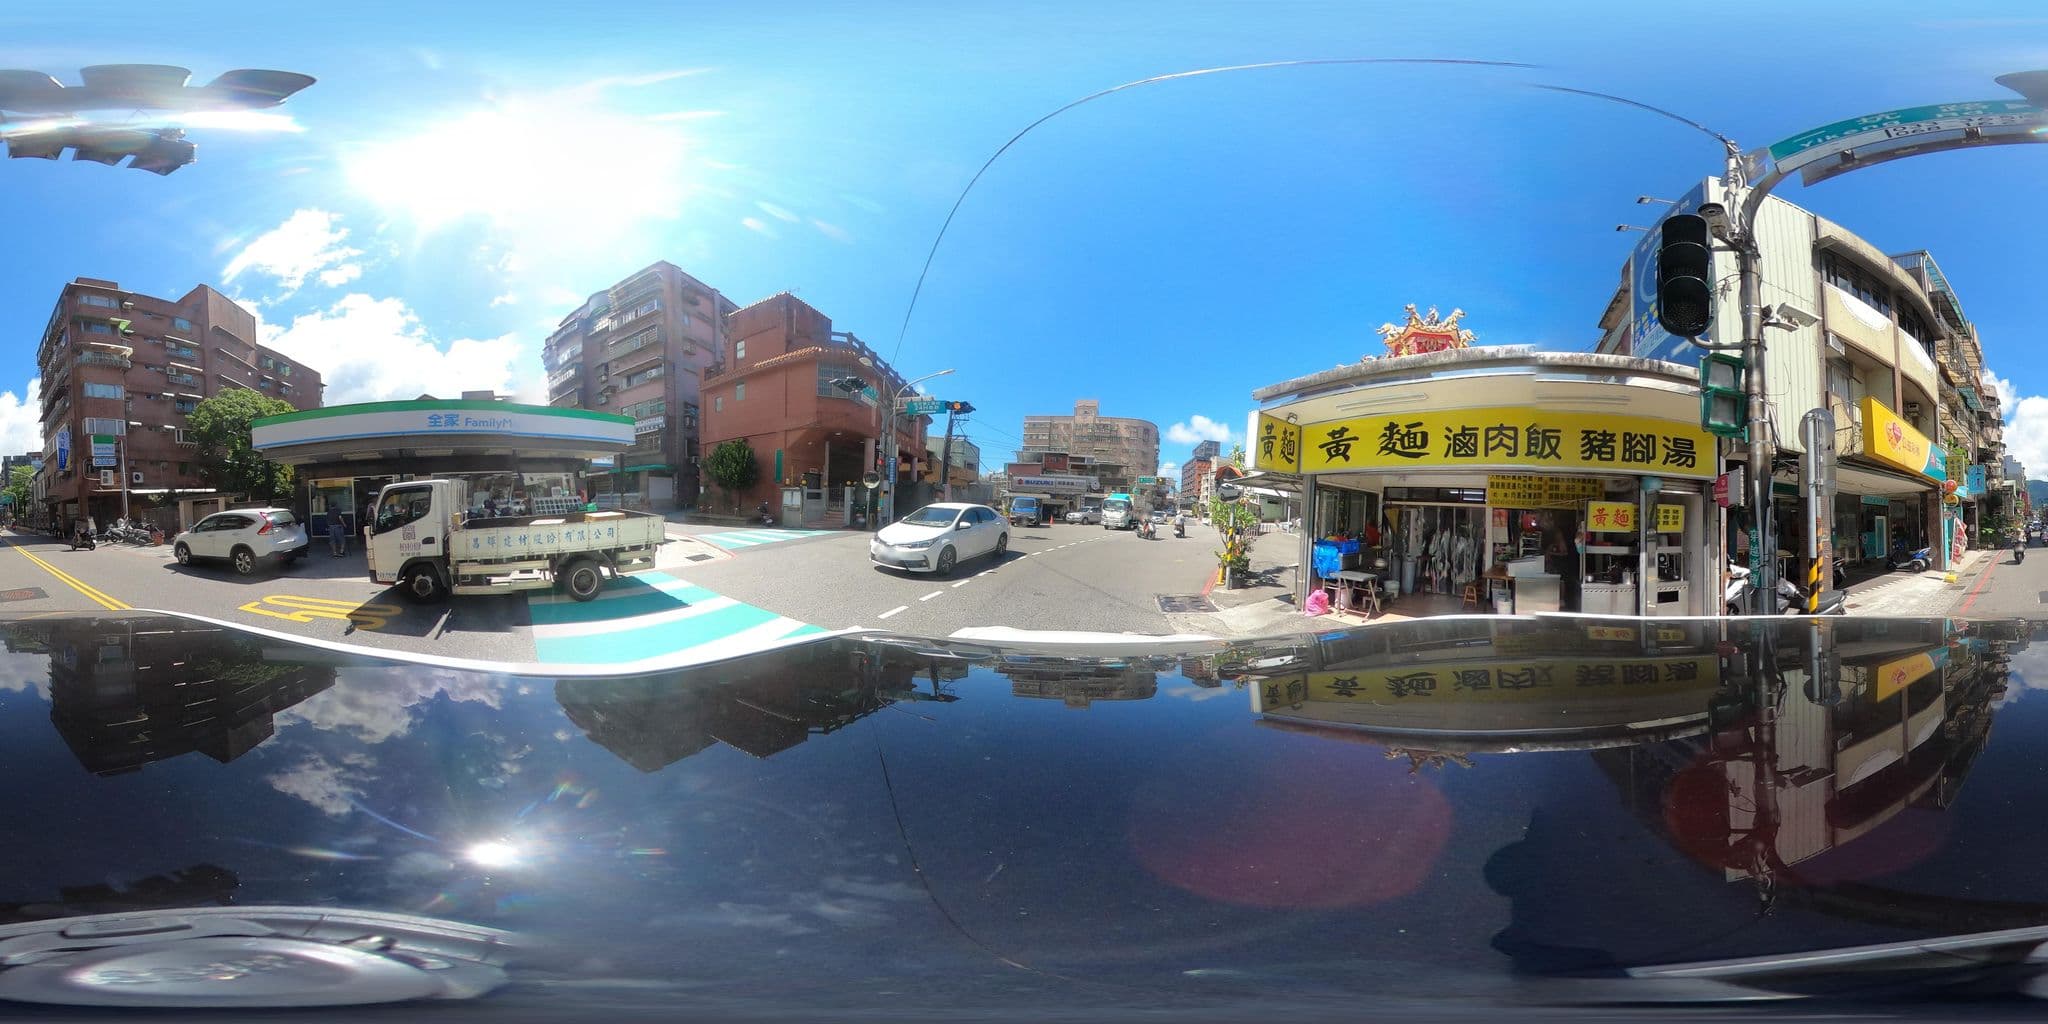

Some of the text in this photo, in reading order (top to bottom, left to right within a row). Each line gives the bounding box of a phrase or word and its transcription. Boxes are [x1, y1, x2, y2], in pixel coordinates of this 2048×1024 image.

[1800, 120, 1902, 147] Yikeng
[428, 413, 460, 428] 全家
[1260, 423, 1296, 464] 黃麵
[1318, 420, 1697, 469] 黃麵 滷肉飯 豬腳湯
[1024, 479, 1054, 487] SUZUKI
[1592, 507, 1630, 528] 黃麵
